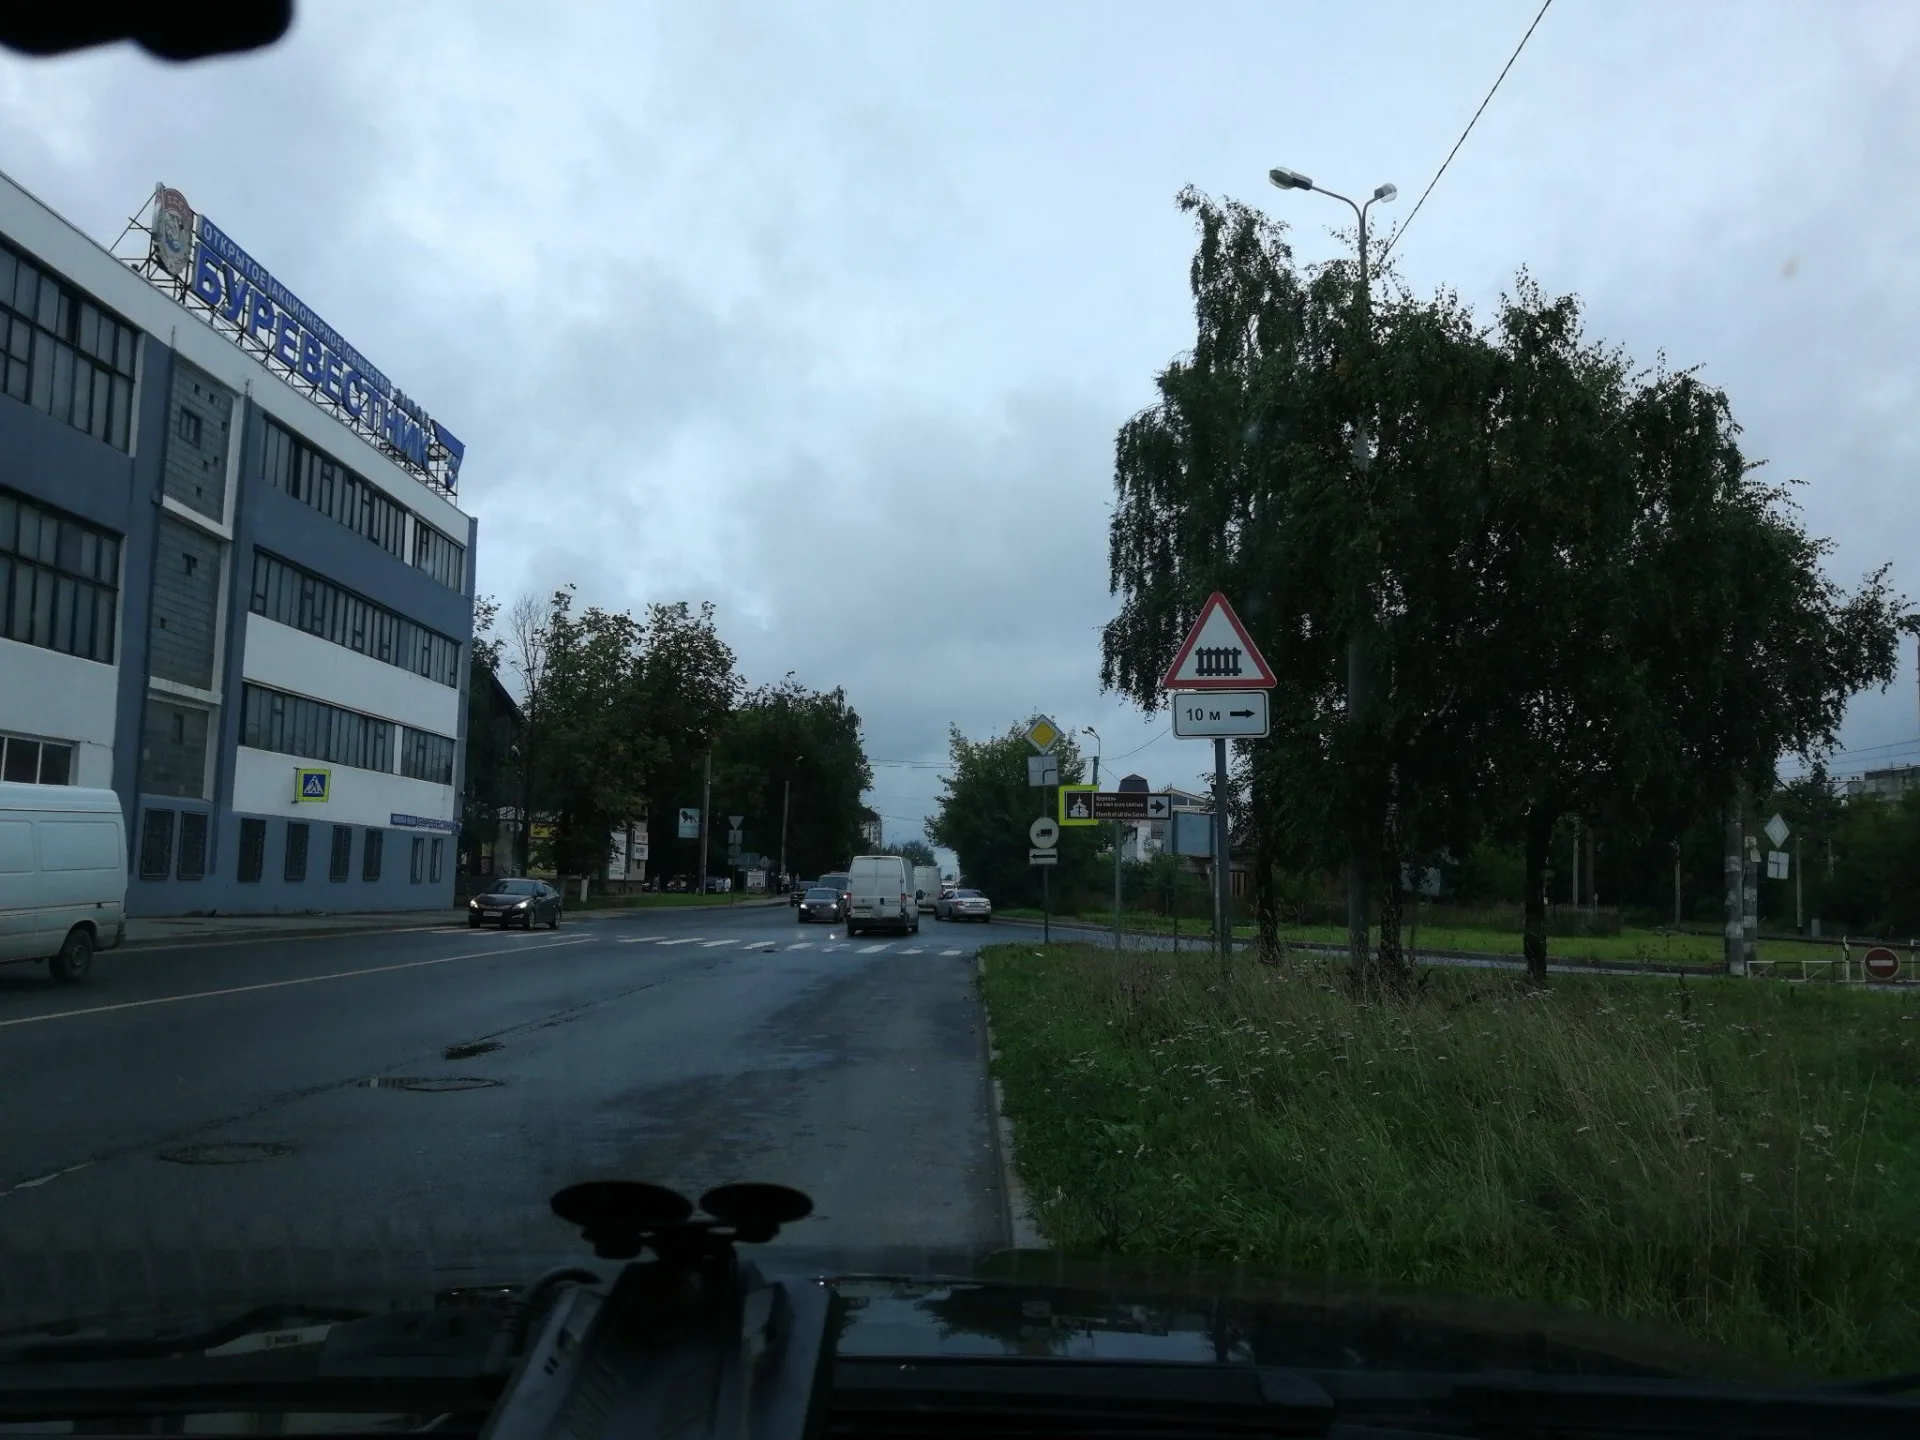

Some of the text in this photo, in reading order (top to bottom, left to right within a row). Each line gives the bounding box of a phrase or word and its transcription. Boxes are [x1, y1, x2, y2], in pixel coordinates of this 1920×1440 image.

[191, 242, 432, 472] БУРЕВЕСТНИК
[203, 223, 267, 289] ОТКРЫТОЕ
[271, 283, 343, 352] АКЦИОНЕРНОЕ
[346, 348, 390, 394] ОБЩЕСТВО
[1186, 708, 1204, 721] 10
